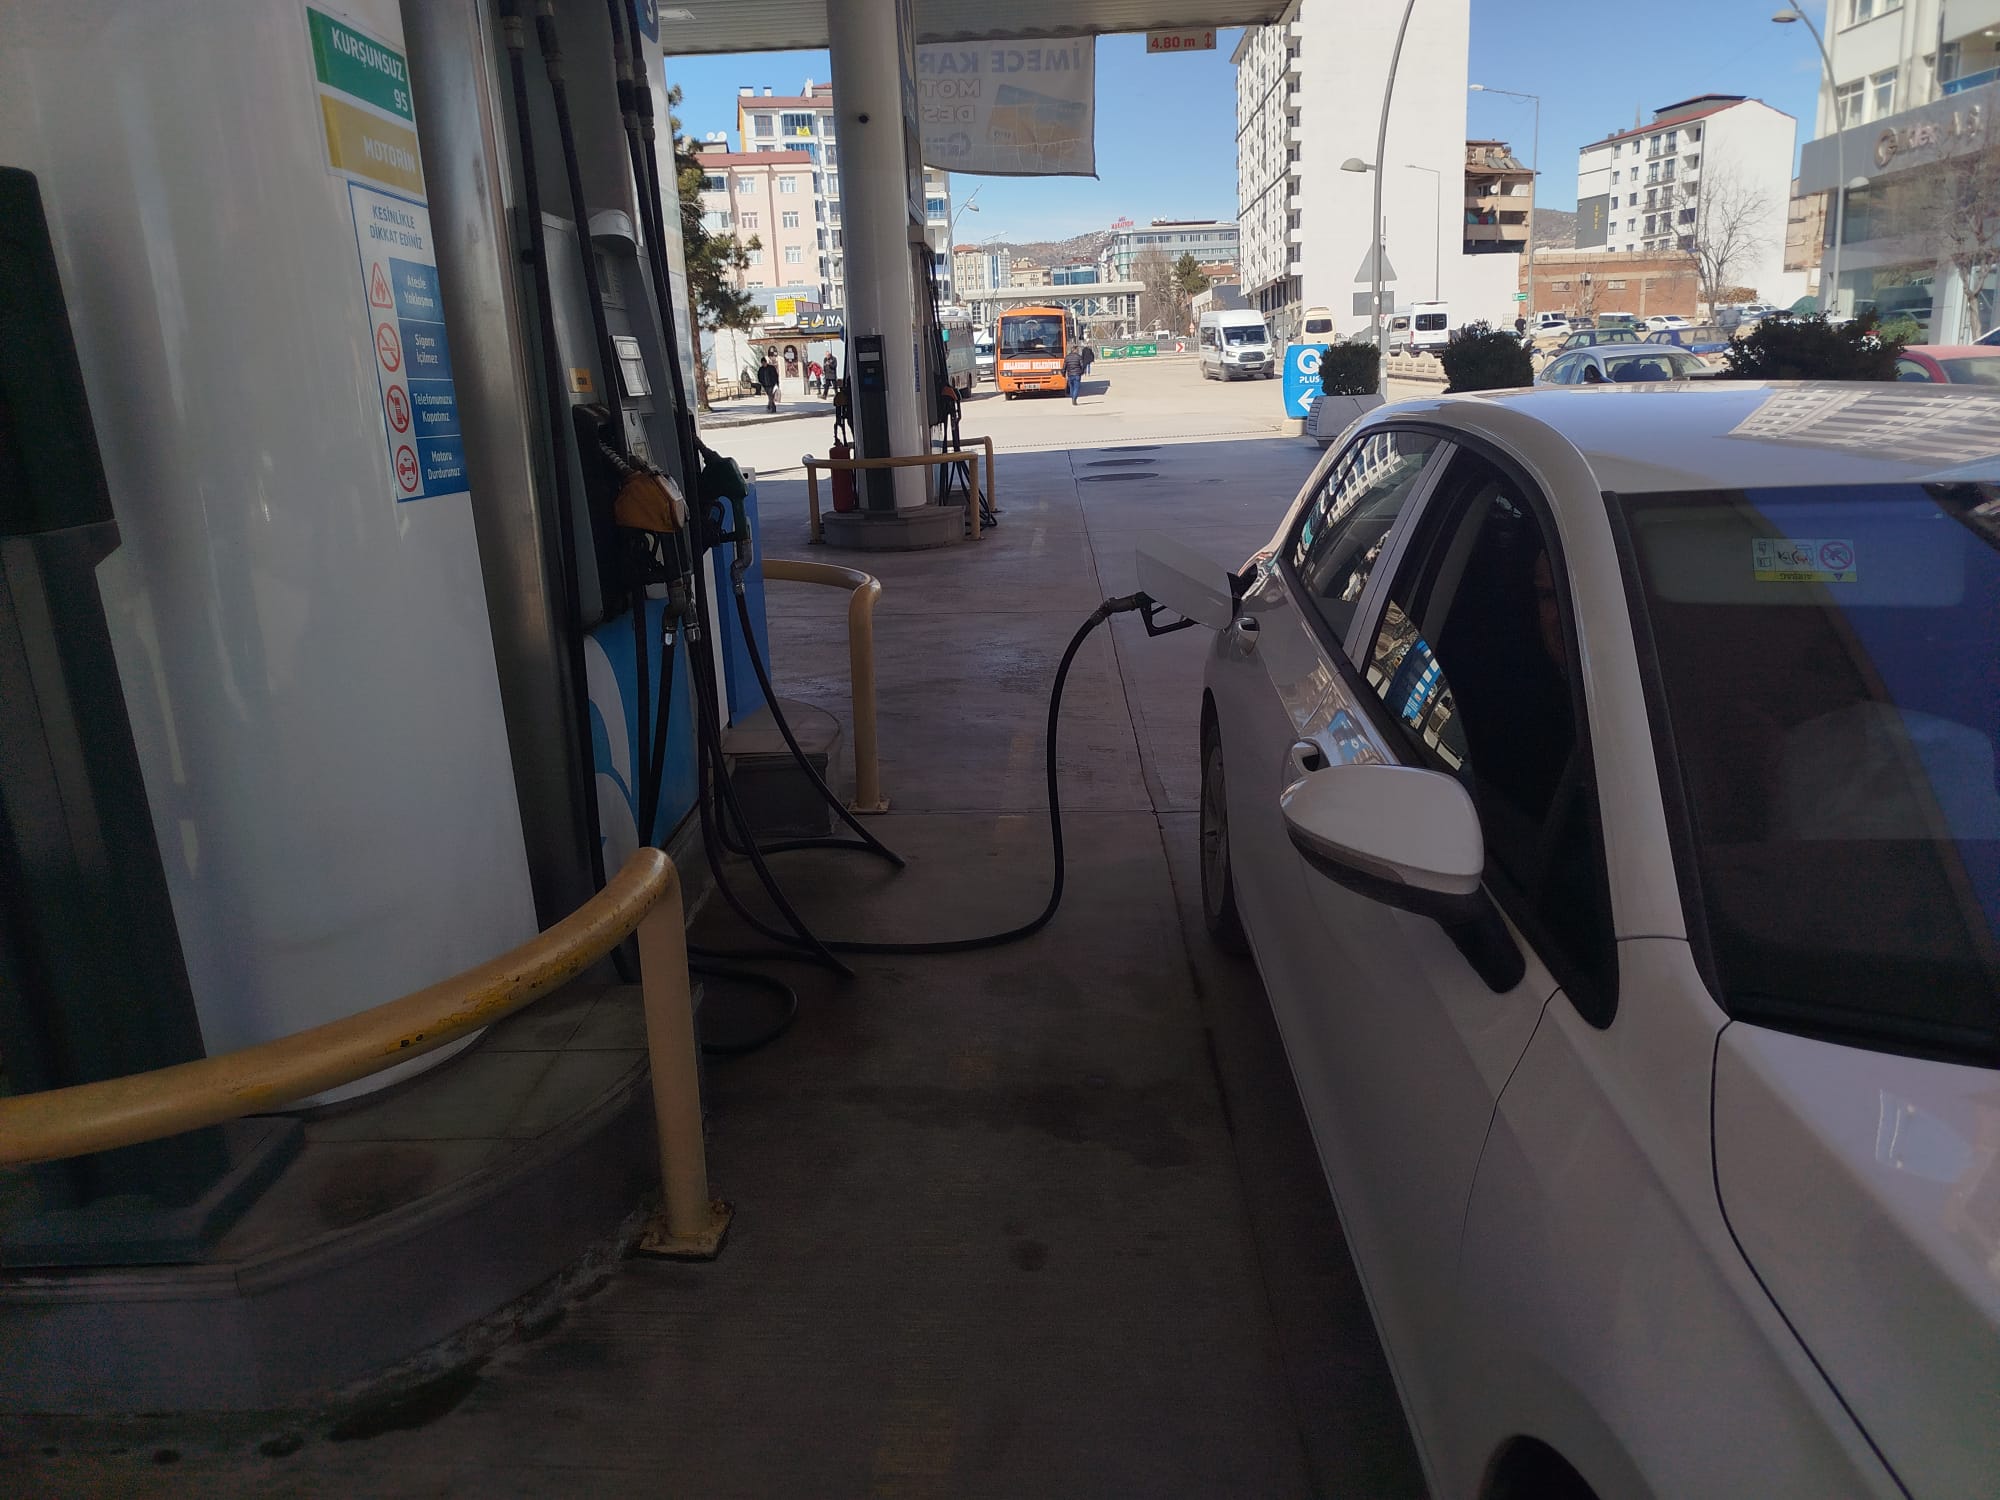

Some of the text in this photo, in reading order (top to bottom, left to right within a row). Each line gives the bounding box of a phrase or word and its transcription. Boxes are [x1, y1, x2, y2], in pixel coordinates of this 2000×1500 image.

[331, 27, 405, 82] KURŞUNSUZ
[1151, 36, 1195, 48] 4.80 m
[393, 88, 408, 113] 95
[363, 135, 416, 174] MOTORİN
[372, 204, 416, 229] KESİNLİKLE
[369, 223, 423, 250] DİKKAT EDİNİZ
[1299, 375, 1320, 384] PLUS
